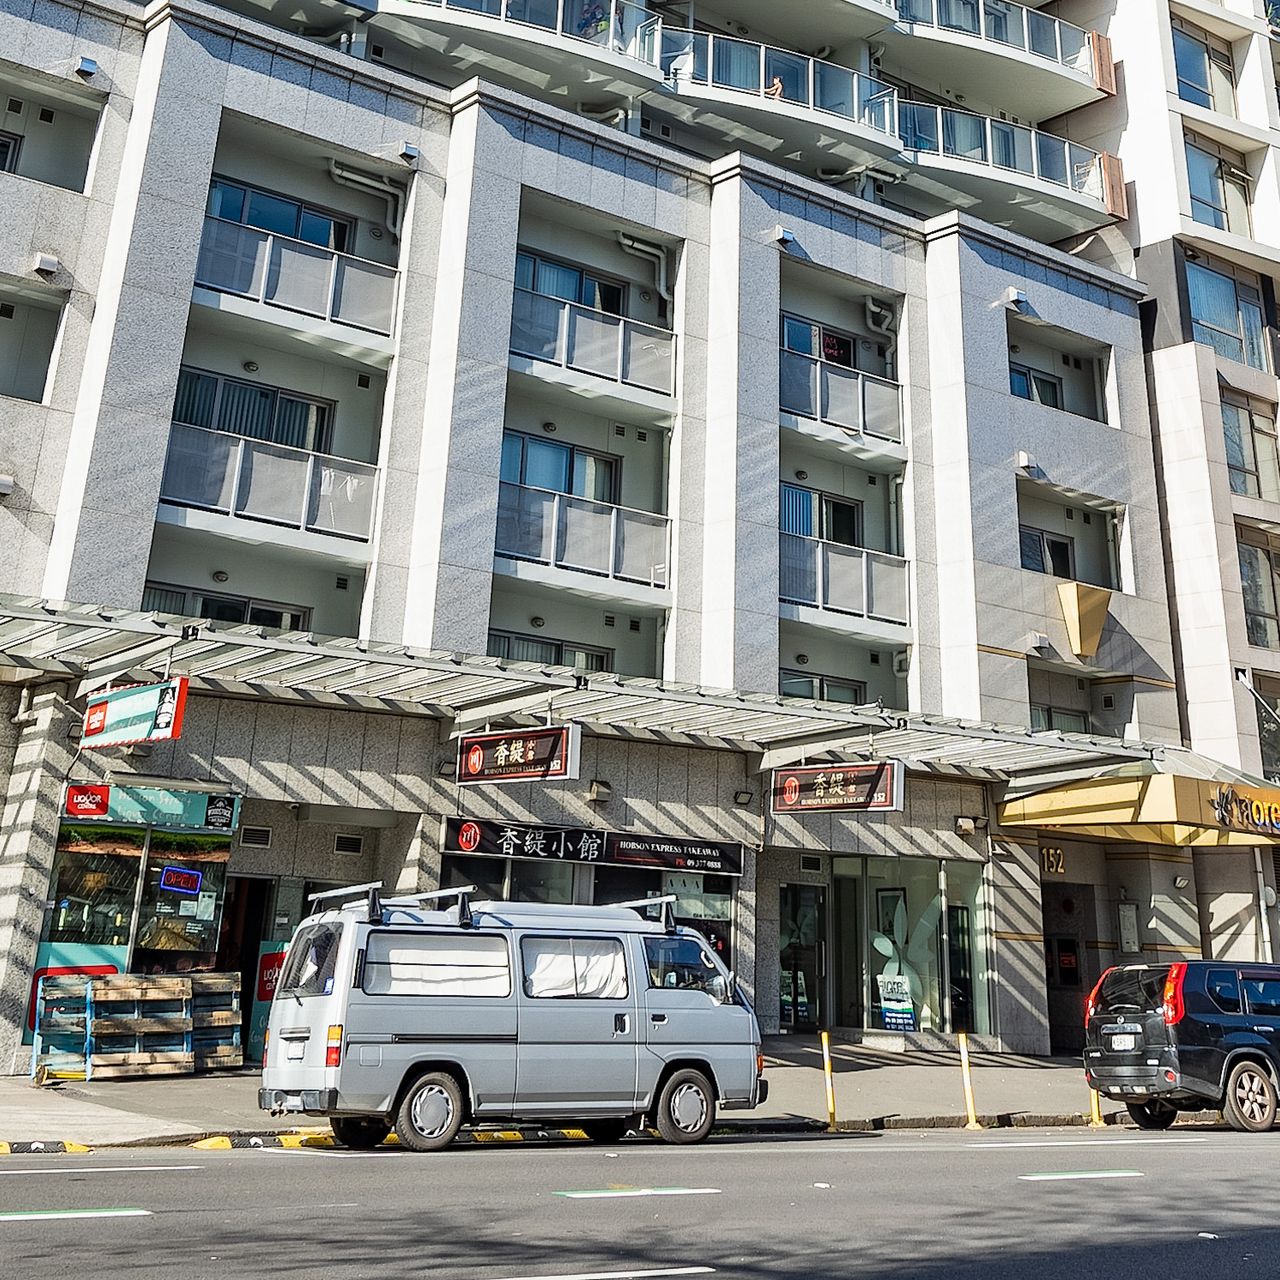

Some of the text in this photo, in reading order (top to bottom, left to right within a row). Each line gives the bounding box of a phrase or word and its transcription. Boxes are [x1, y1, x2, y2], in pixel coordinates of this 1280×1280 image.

[73, 792, 102, 803] LIQUOR
[873, 793, 886, 802] 152
[497, 828, 601, 860] 香緹小館
[620, 841, 720, 857] HOBSON EXPRESS TAKEAWAY
[1041, 847, 1065, 873] 152
[165, 871, 197, 888] OPEN
